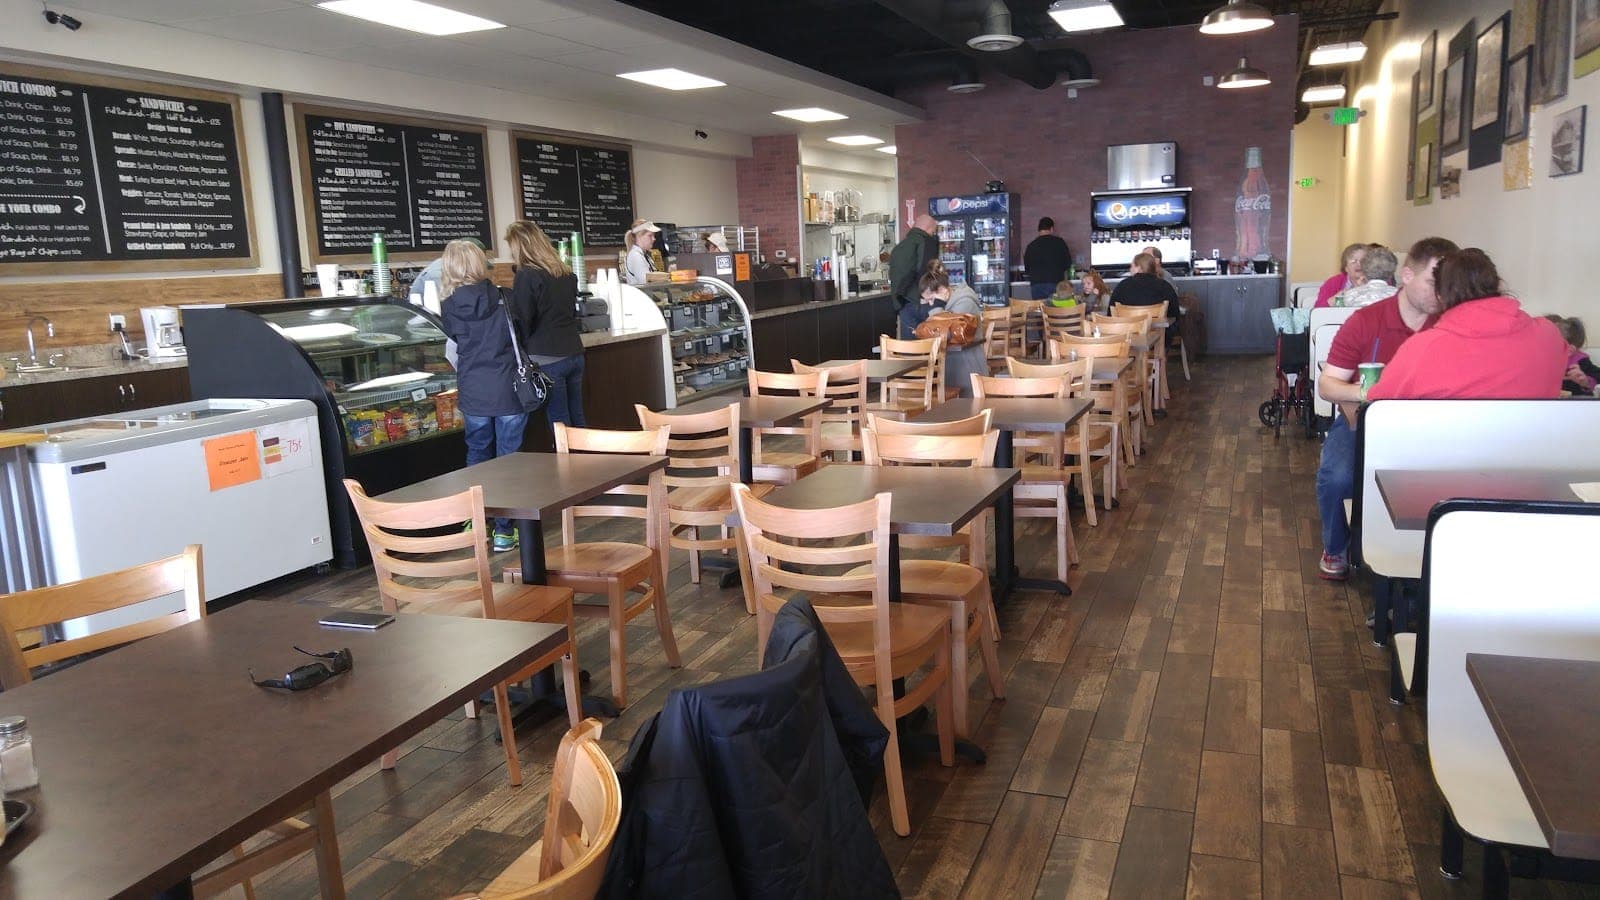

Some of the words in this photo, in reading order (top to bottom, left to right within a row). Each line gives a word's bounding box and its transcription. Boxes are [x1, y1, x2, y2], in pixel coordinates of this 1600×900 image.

[21, 83, 57, 97] COMBOS
[140, 97, 185, 112] SANDWICHES
[8, 204, 31, 213] YOUR
[32, 204, 61, 213] COMBO
[962, 199, 988, 210] pepsi
[1129, 202, 1172, 219] pepsi
